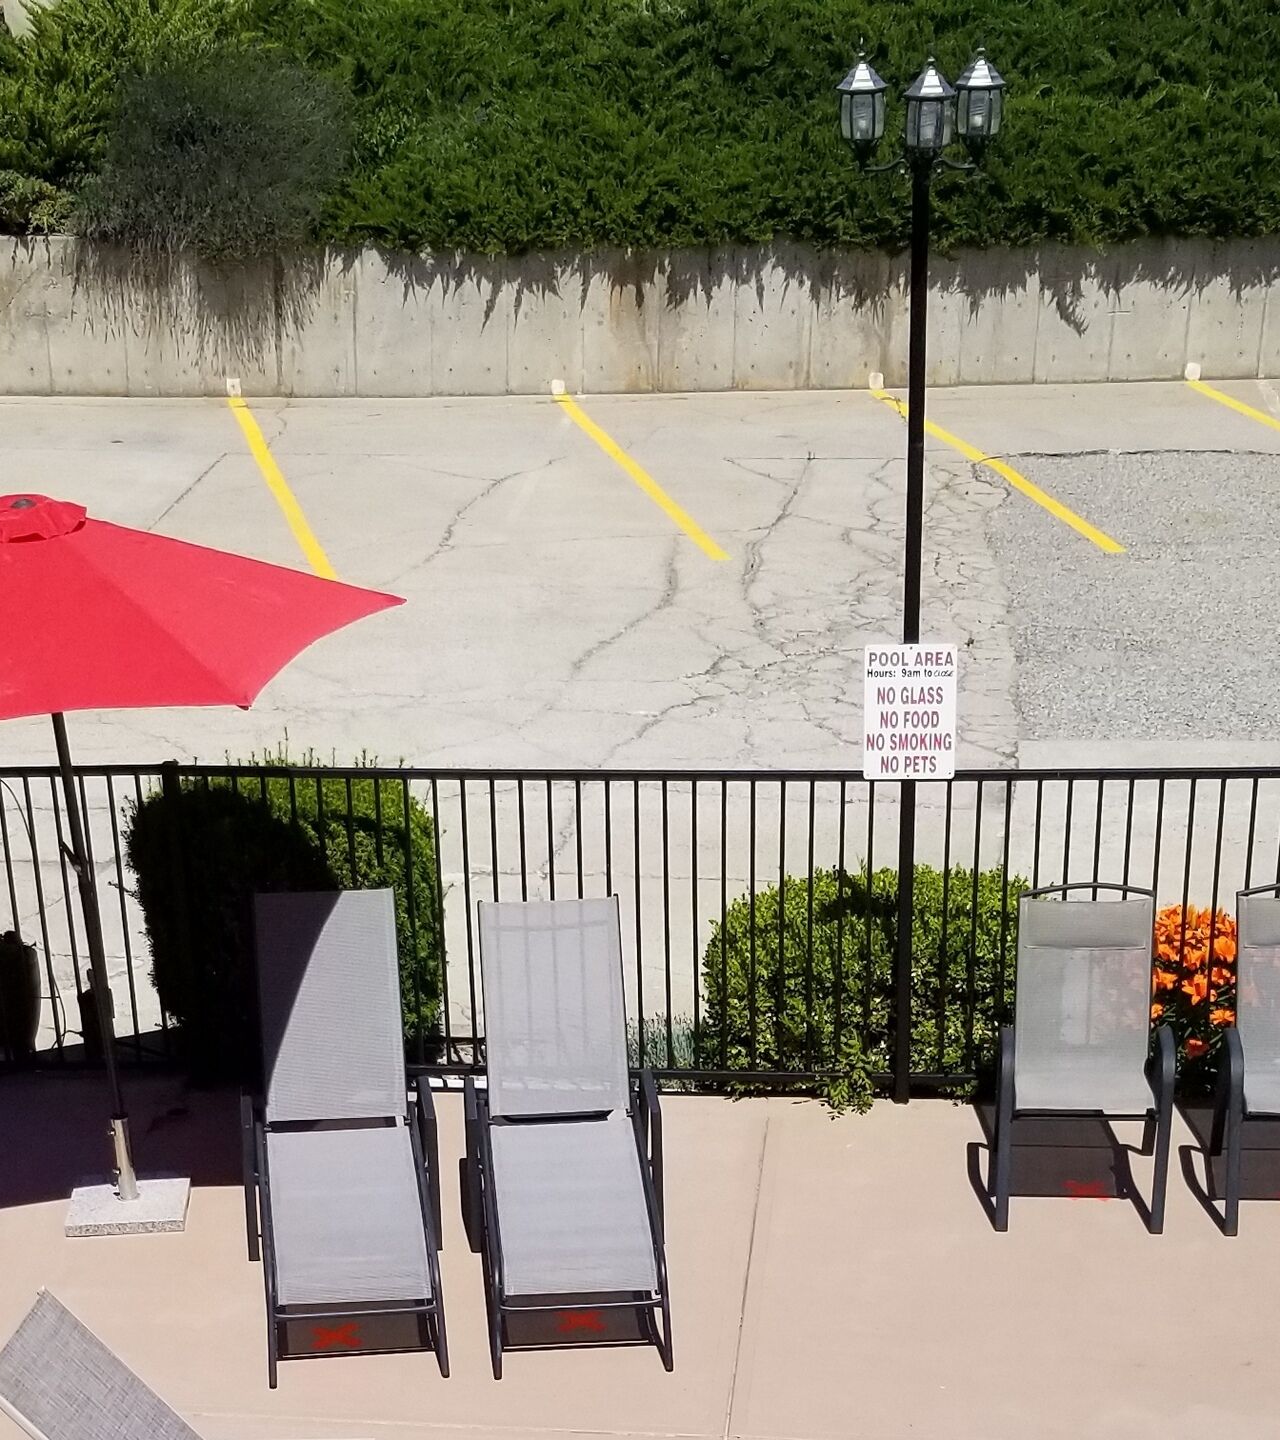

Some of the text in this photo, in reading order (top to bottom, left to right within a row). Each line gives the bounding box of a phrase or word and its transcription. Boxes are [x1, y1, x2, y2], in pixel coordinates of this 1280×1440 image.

[868, 652, 954, 667] POOL AREA
[867, 669, 897, 678] Hours:
[901, 668, 921, 678] 9am
[924, 668, 933, 678] to
[877, 687, 944, 705] NO GLASS
[880, 711, 940, 729] NO FOOD
[866, 733, 952, 751] NO SMOKING
[880, 756, 937, 773] NO PETS
